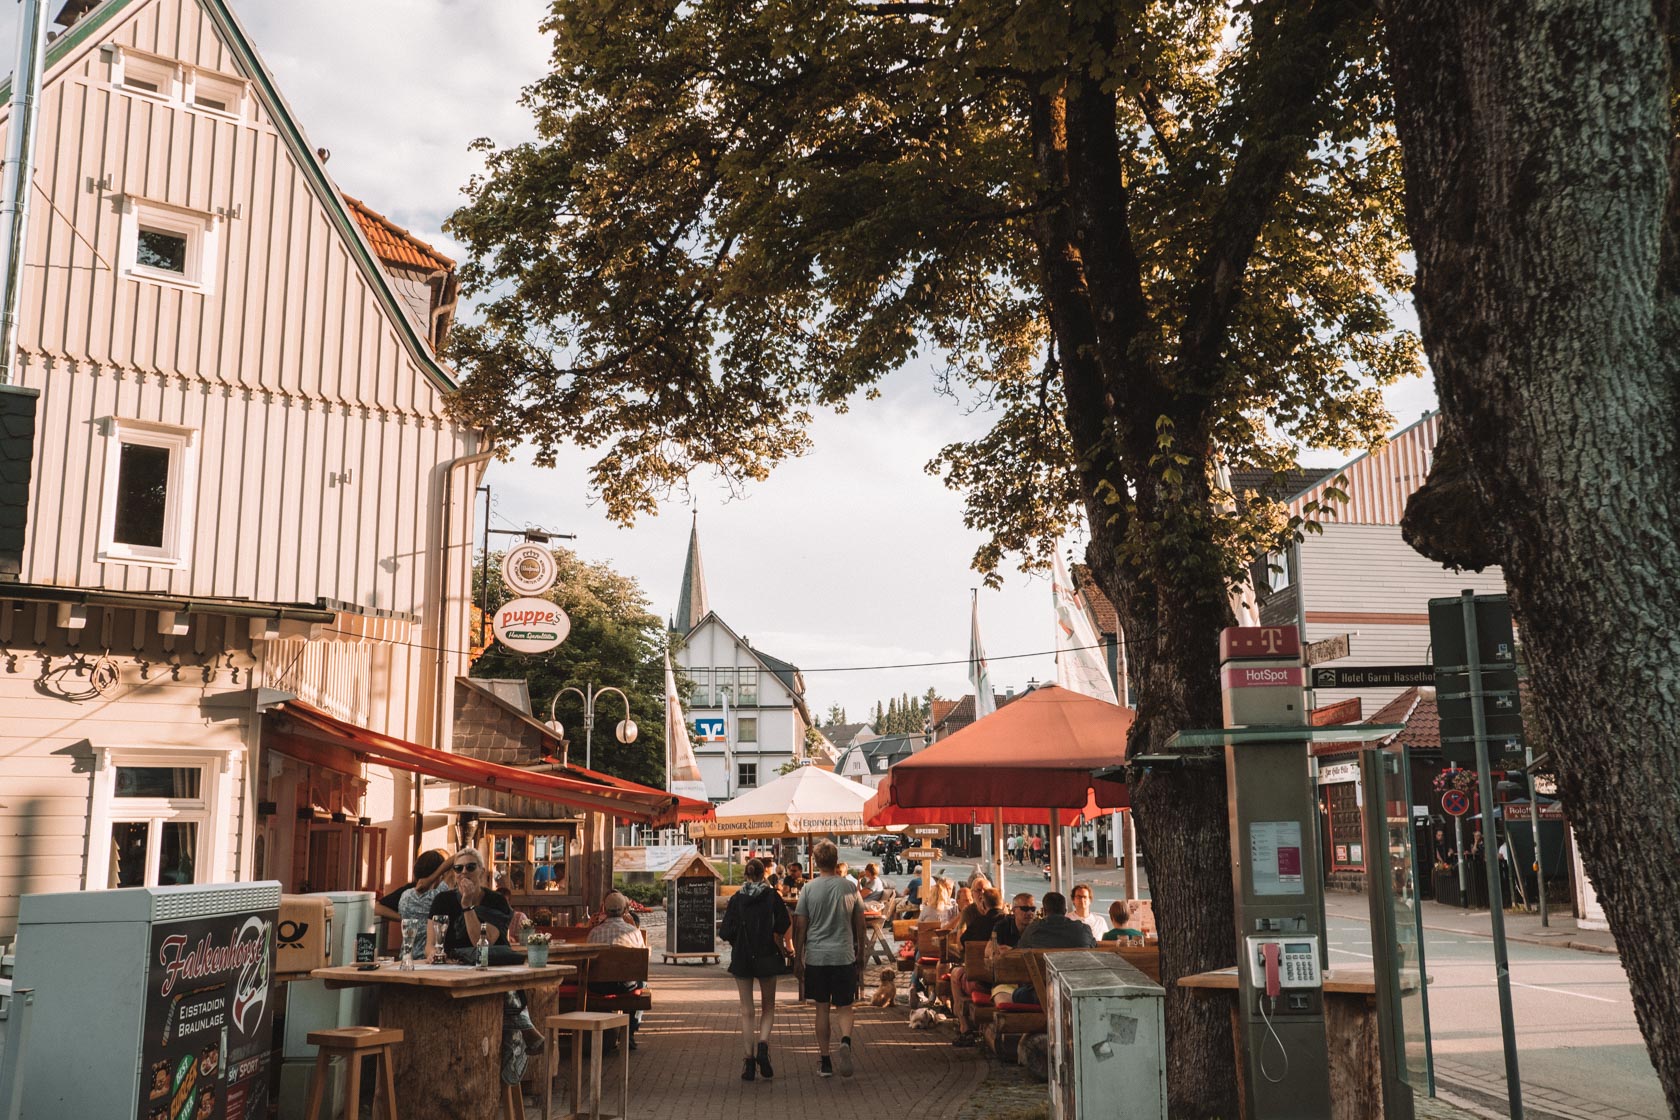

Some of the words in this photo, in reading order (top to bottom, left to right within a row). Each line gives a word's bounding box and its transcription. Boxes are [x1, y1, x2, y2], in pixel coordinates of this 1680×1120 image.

[502, 610, 561, 628] puppe's
[1246, 669, 1288, 682] HotSpot
[1341, 672, 1364, 683] Hotel
[1367, 672, 1391, 683] Garni
[717, 822, 748, 831] ERDINGER
[803, 818, 838, 828] ERDINGER
[160, 927, 264, 997] Falkenhorst
[180, 997, 225, 1020] EISSTADION
[178, 1013, 225, 1038] BRAUNLAGE
[176, 1057, 189, 1084] BEST
[228, 1065, 238, 1083] sky
[239, 1058, 260, 1078] SPORT
